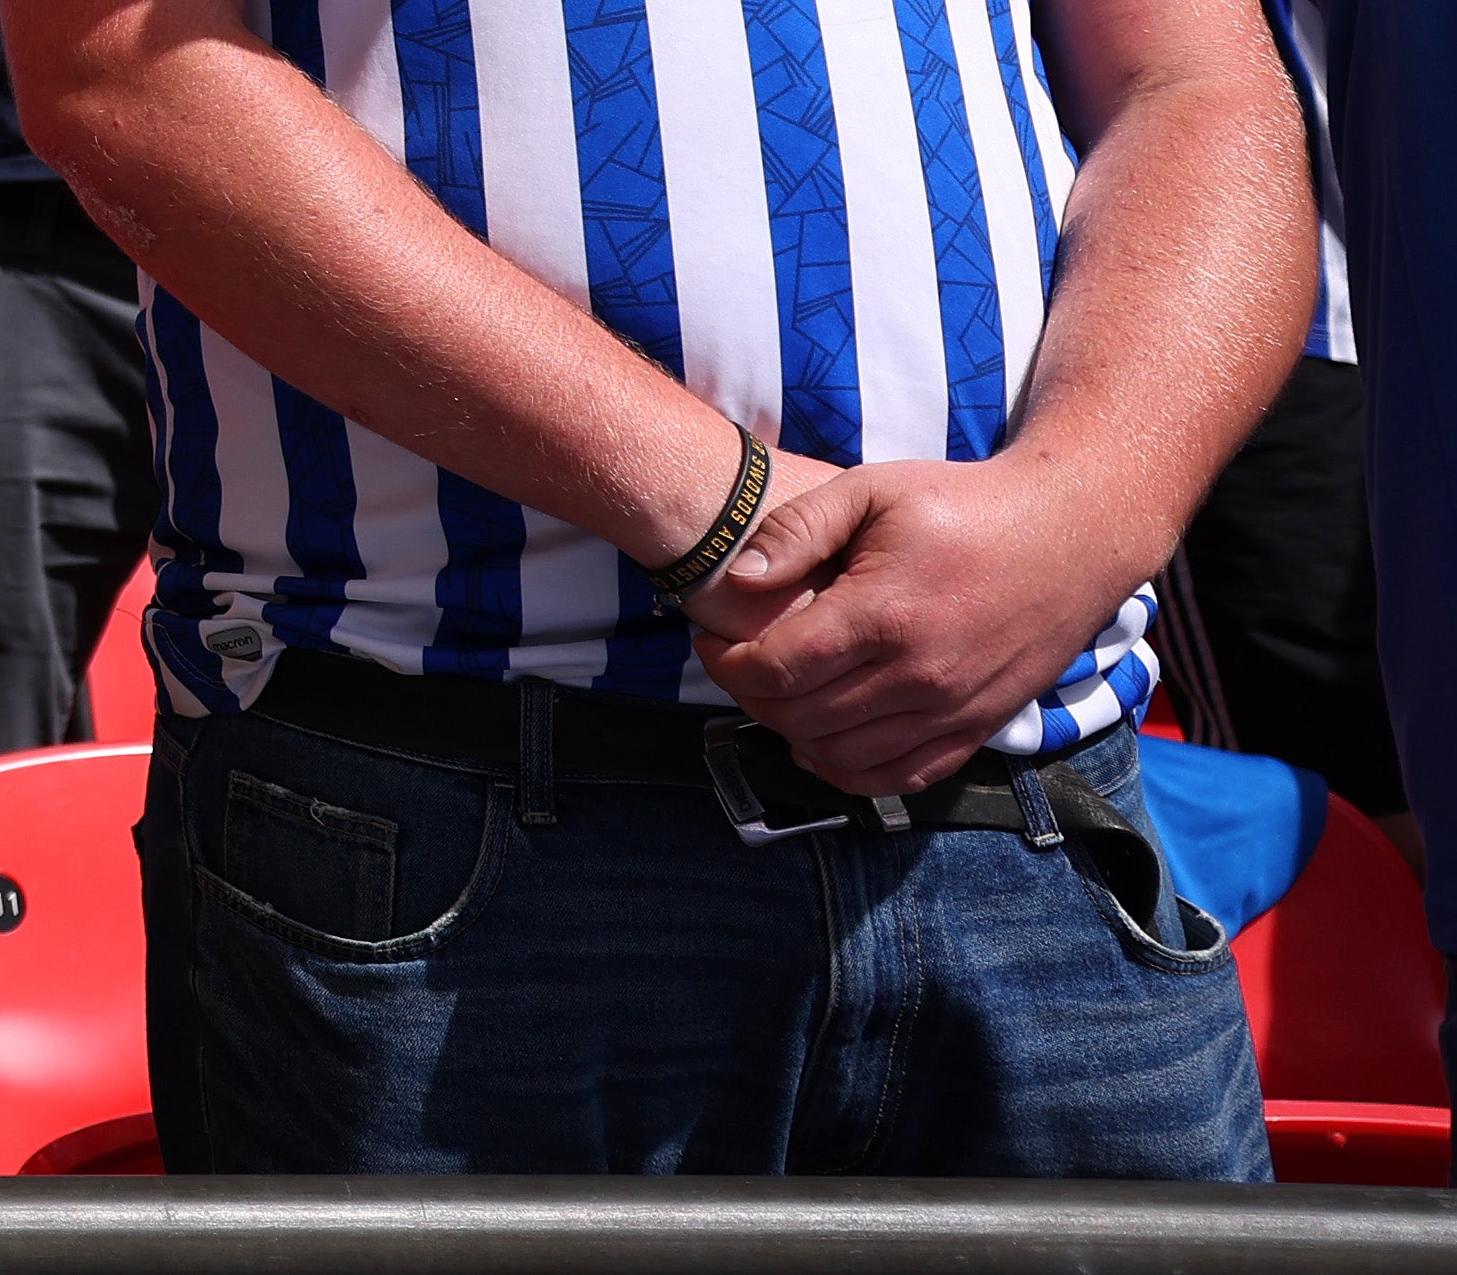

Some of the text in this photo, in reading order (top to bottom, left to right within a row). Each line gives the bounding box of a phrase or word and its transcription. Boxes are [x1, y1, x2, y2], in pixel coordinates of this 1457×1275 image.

[730, 455, 767, 526] SWORDS
[668, 525, 736, 586] AGAINST
[212, 636, 254, 652] macron
